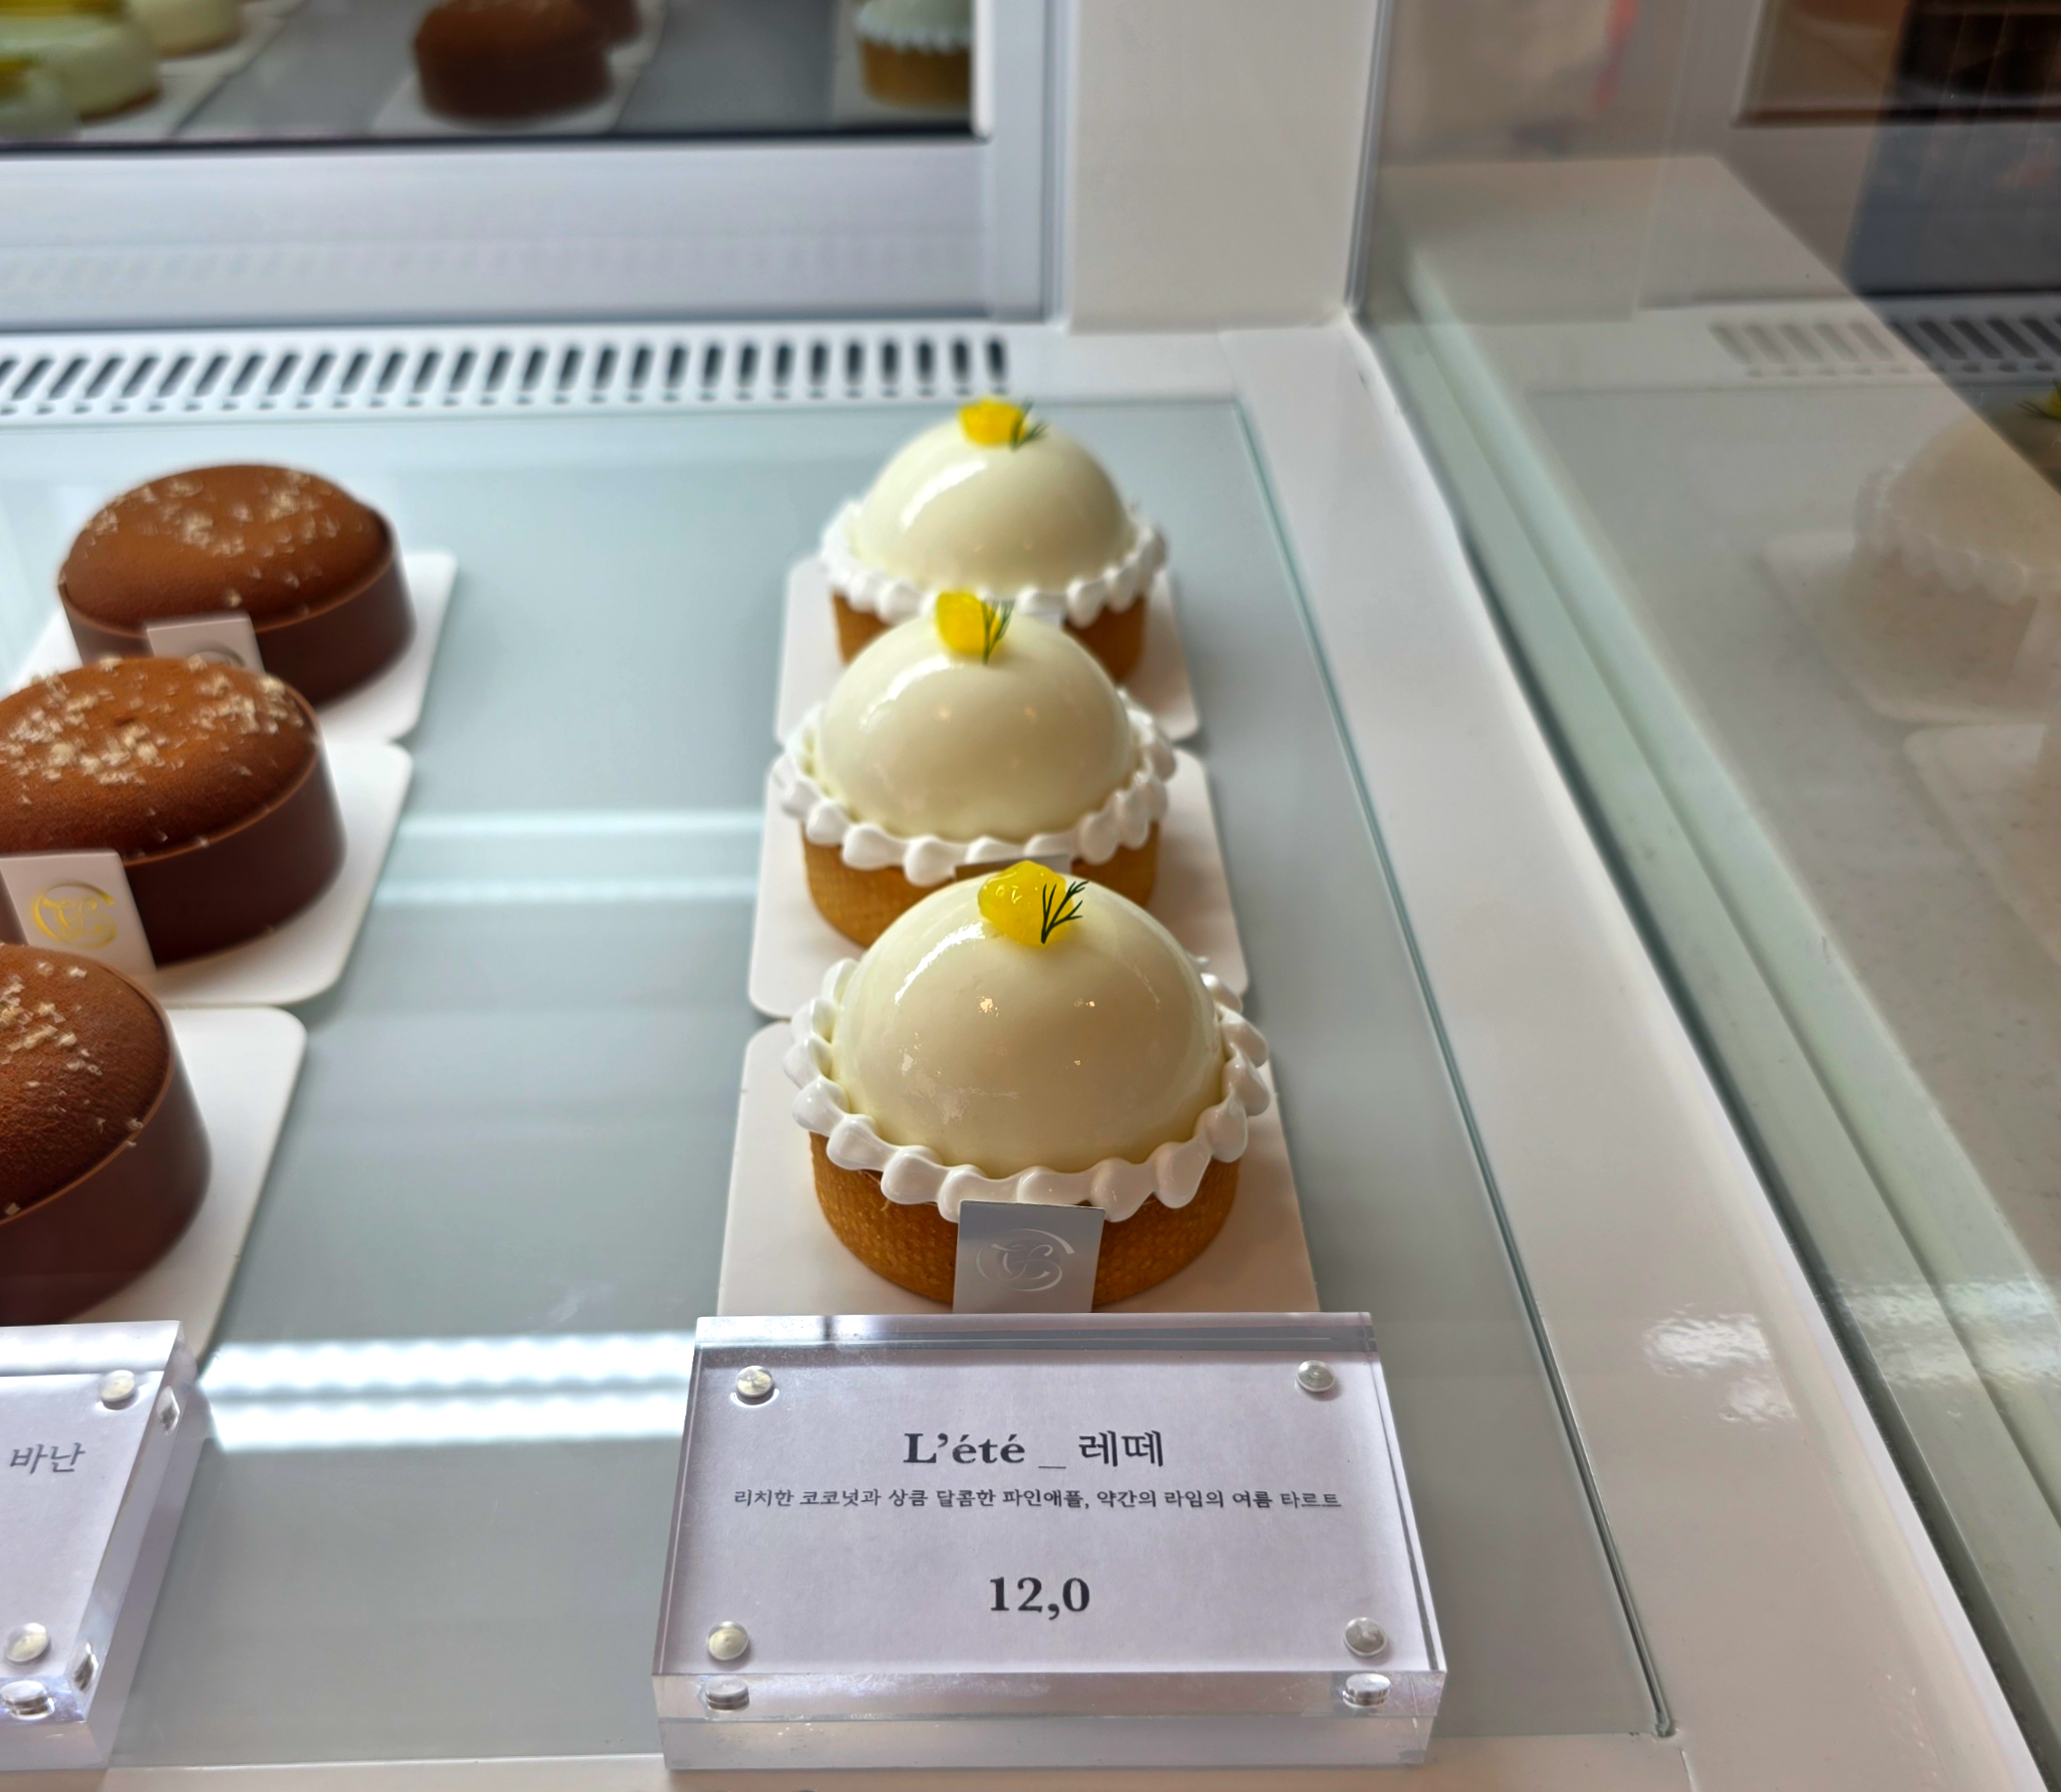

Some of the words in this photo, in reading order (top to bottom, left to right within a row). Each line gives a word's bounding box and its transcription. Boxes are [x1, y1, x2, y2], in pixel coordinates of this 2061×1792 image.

[9, 1441, 87, 1475] 바난
[1078, 1429, 1164, 1468] 레떼
[733, 1488, 795, 1508] 리치한
[799, 1487, 883, 1508] 코코넛과
[888, 1488, 929, 1508] 상큼
[935, 1488, 997, 1508] 달콤한
[1002, 1488, 1090, 1510] 파인애플,
[1096, 1489, 1158, 1509] 약간의
[1163, 1489, 1224, 1509] 라임의
[1231, 1489, 1274, 1509] 여름
[1280, 1490, 1343, 1510] 타르트
[989, 1576, 1091, 1622] 12,0
